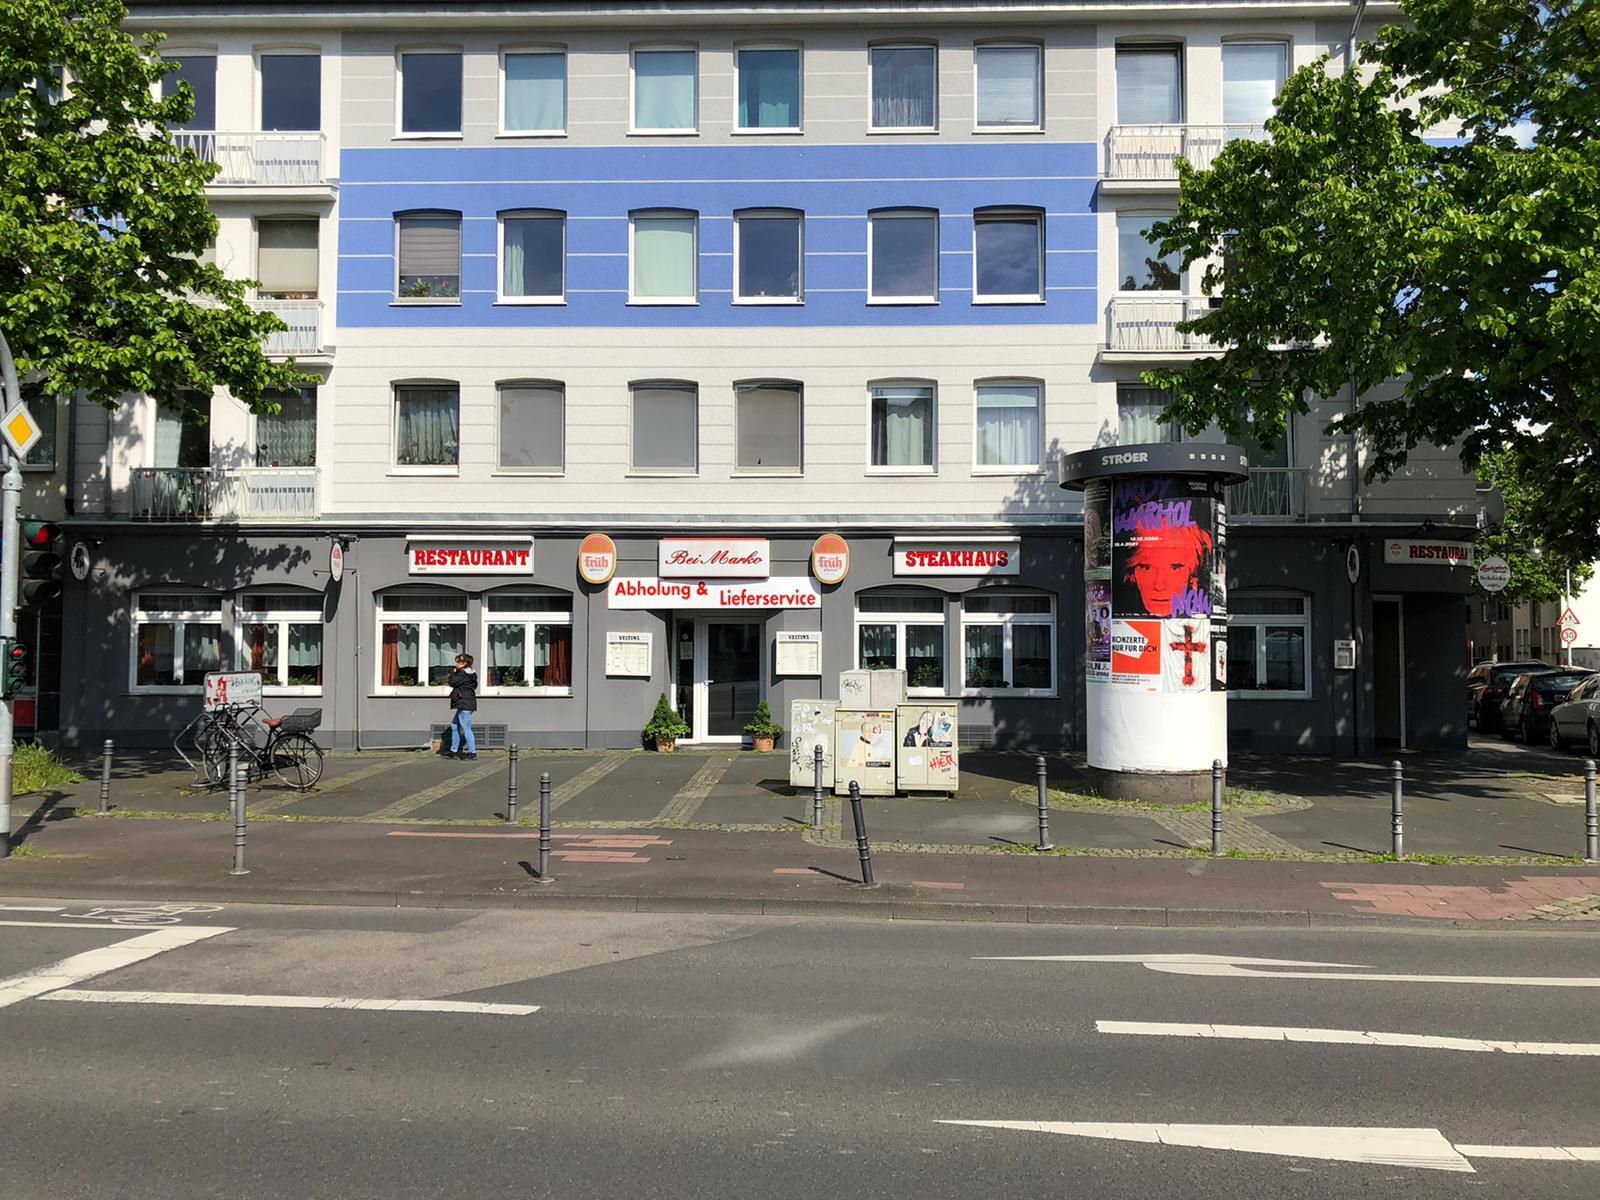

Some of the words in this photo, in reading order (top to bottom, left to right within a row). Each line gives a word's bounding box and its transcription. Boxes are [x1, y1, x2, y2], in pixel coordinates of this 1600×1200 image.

[1101, 452, 1148, 465] STRÖER
[1115, 500, 1196, 534] WARHOL
[414, 549, 529, 566] RESTAURANT
[665, 550, 699, 565] Bei
[699, 550, 763, 565] Marko
[905, 550, 1008, 567] STEAKHAUS
[615, 581, 691, 600] Abholung
[697, 582, 708, 596] &
[720, 589, 816, 606] Lieferservice
[1171, 586, 1211, 618] NOW
[1112, 636, 1145, 644] KONZERTE
